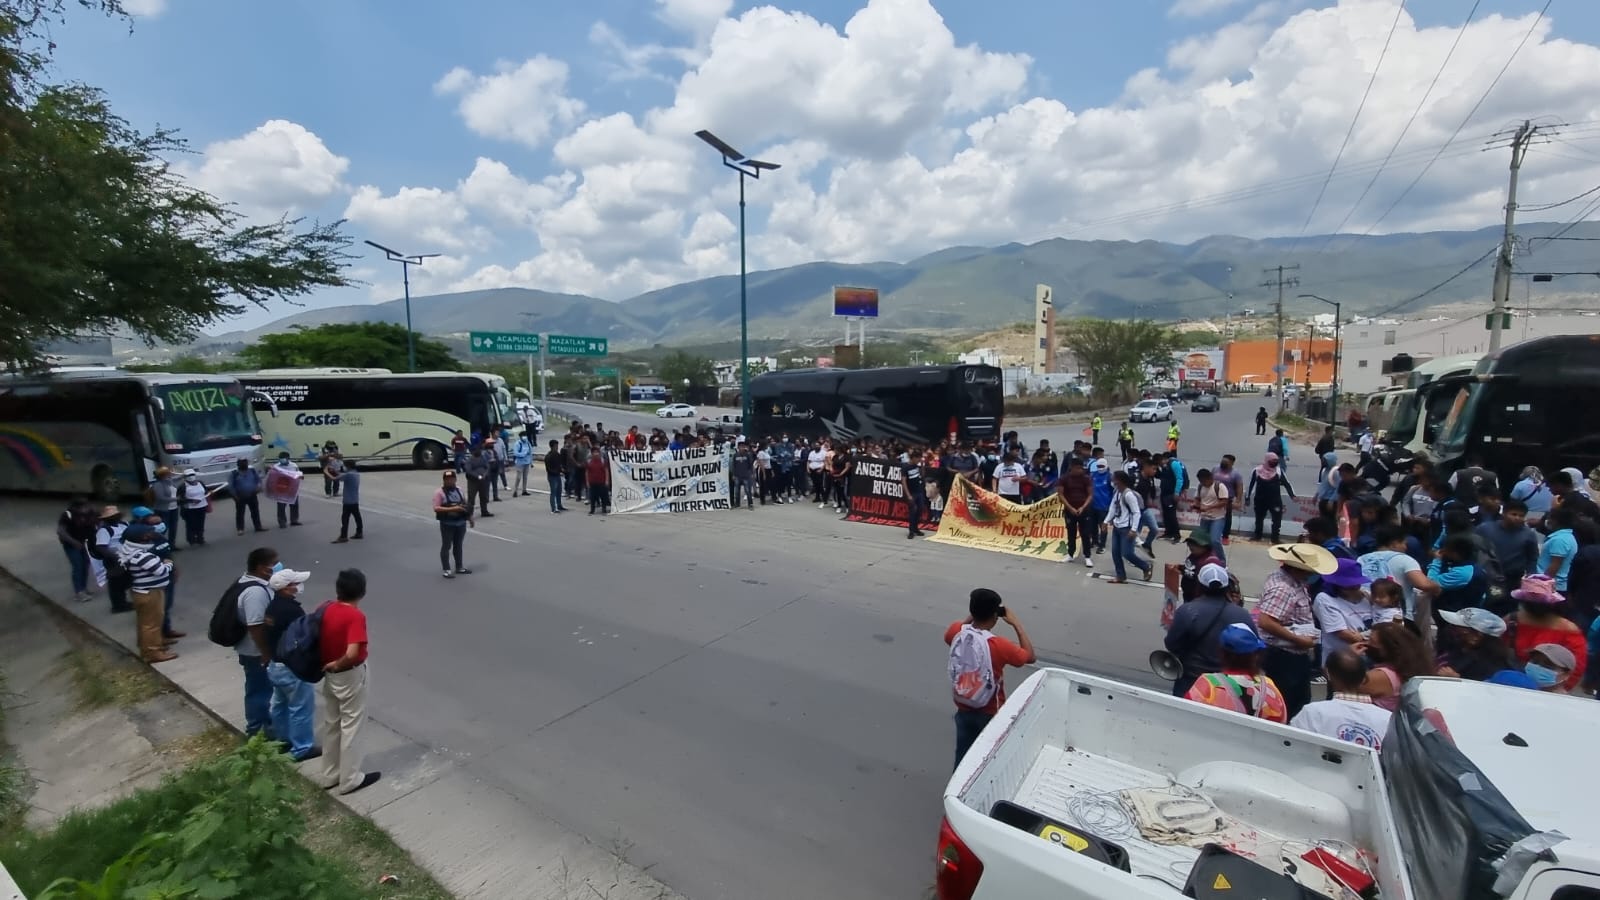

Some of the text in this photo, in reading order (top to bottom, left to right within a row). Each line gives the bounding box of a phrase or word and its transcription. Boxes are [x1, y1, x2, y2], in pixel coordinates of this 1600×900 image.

[496, 336, 537, 344] ACAPULCO
[168, 387, 228, 412] AYOTZI
[295, 413, 340, 426] Costa
[611, 450, 655, 463] PORQUE
[671, 447, 706, 461] VIVOS
[713, 444, 725, 456] SE
[631, 468, 653, 480] LOS
[668, 461, 721, 480] LLEVARON
[855, 461, 885, 480] ANGEL
[886, 466, 902, 481] AGU
[653, 485, 686, 499] VIVOS
[697, 481, 716, 494] LOS
[872, 480, 904, 498] RIVERO
[669, 499, 730, 513] QUEREMOS
[852, 496, 890, 516] MALDITO
[1001, 521, 1025, 537] Nos
